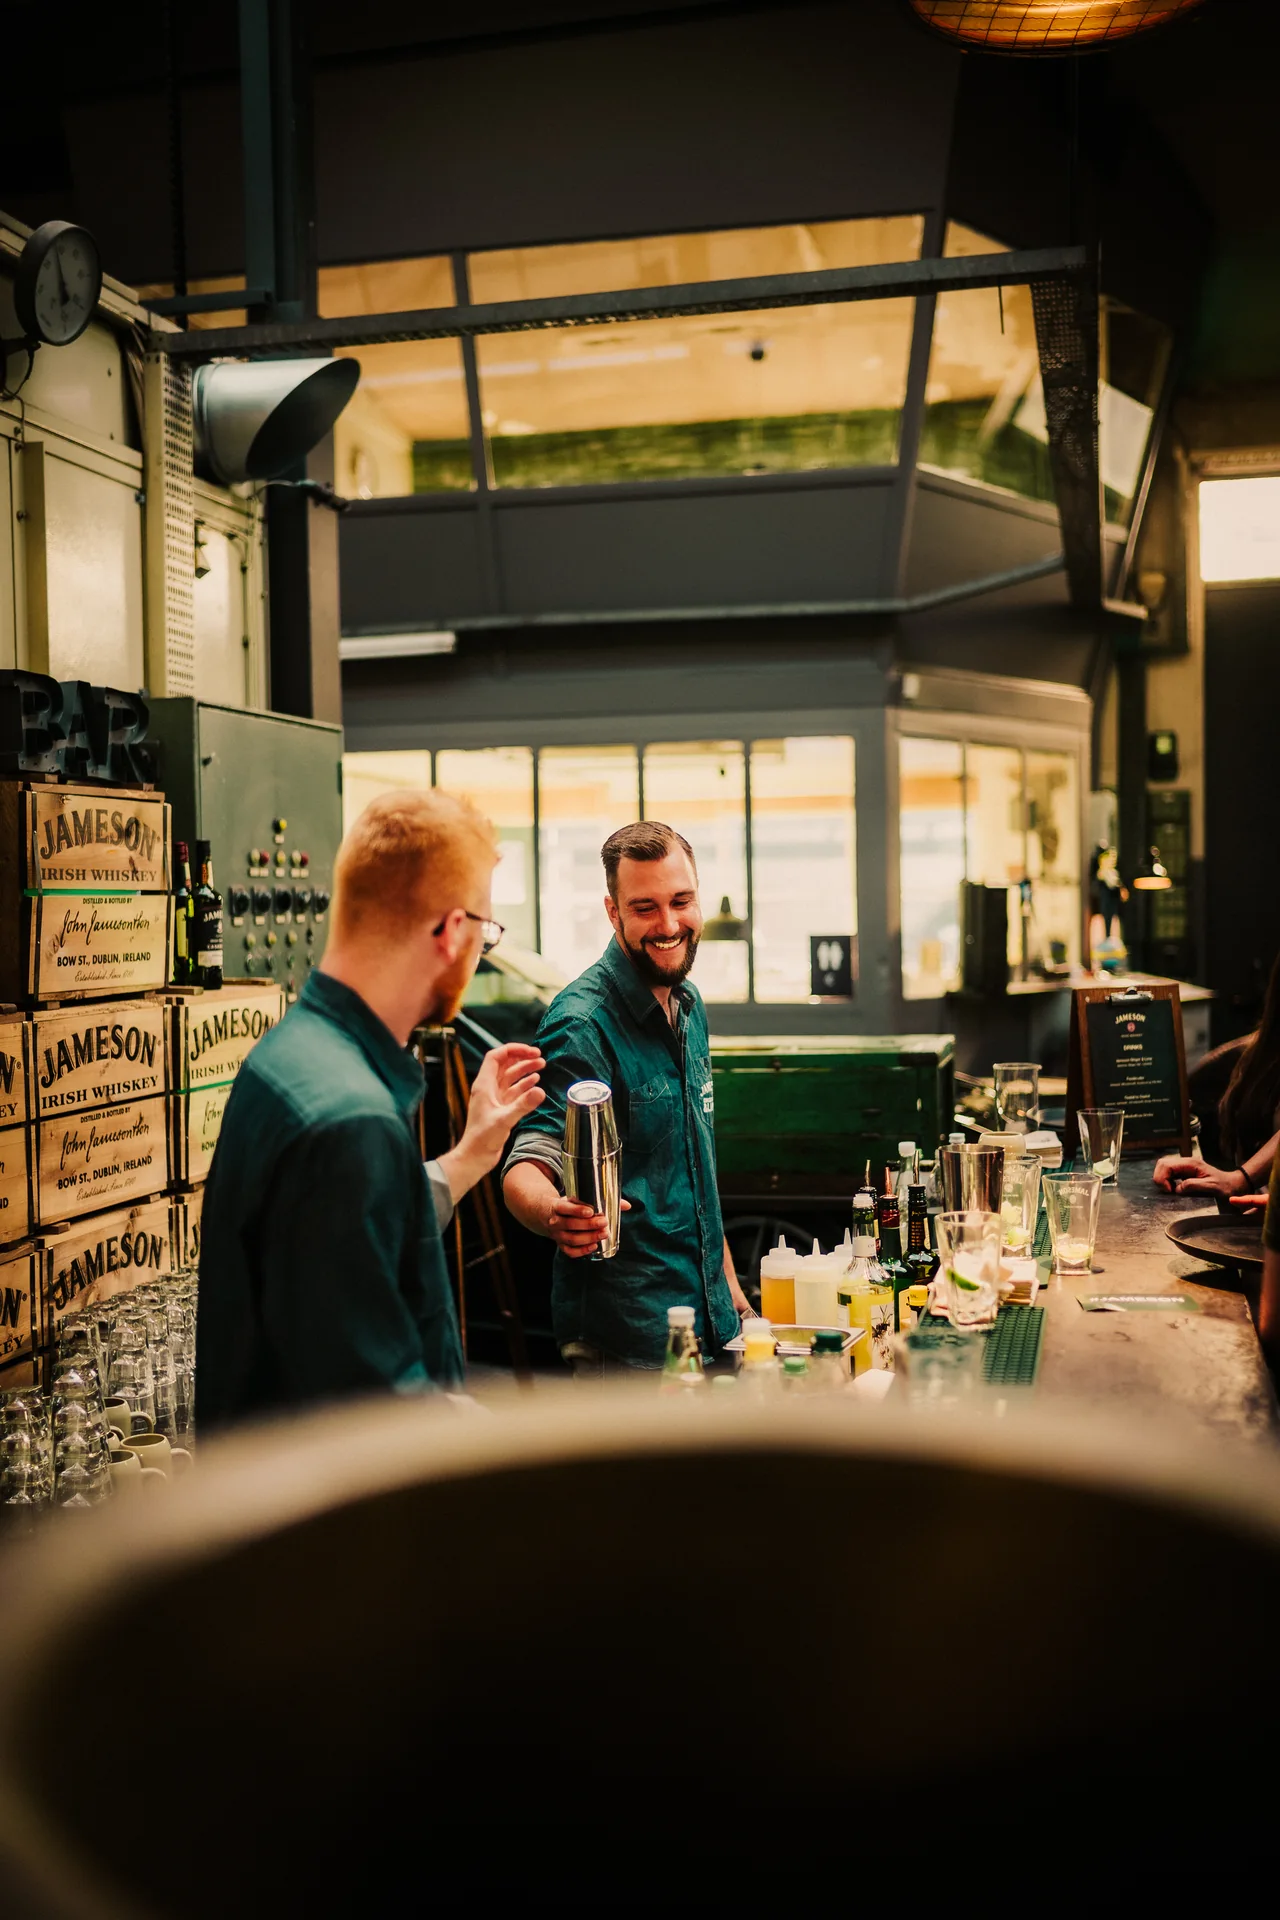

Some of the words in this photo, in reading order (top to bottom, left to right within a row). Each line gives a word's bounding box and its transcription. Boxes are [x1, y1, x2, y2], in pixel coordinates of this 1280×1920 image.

[13, 669, 159, 784] BAR
[41, 867, 86, 881] IRISH
[91, 868, 157, 882] WHISKEY
[60, 909, 86, 948] John
[57, 956, 76, 967] BOW
[122, 952, 151, 963] IRELAND
[191, 1064, 224, 1080] IRISH
[41, 1089, 87, 1109] IRISH
[92, 1075, 158, 1099] WHISKEY
[80, 1113, 101, 1123] DISTILLED
[60, 1131, 86, 1171] John
[58, 1174, 77, 1190] BOW
[123, 1155, 152, 1171] IRELAND
